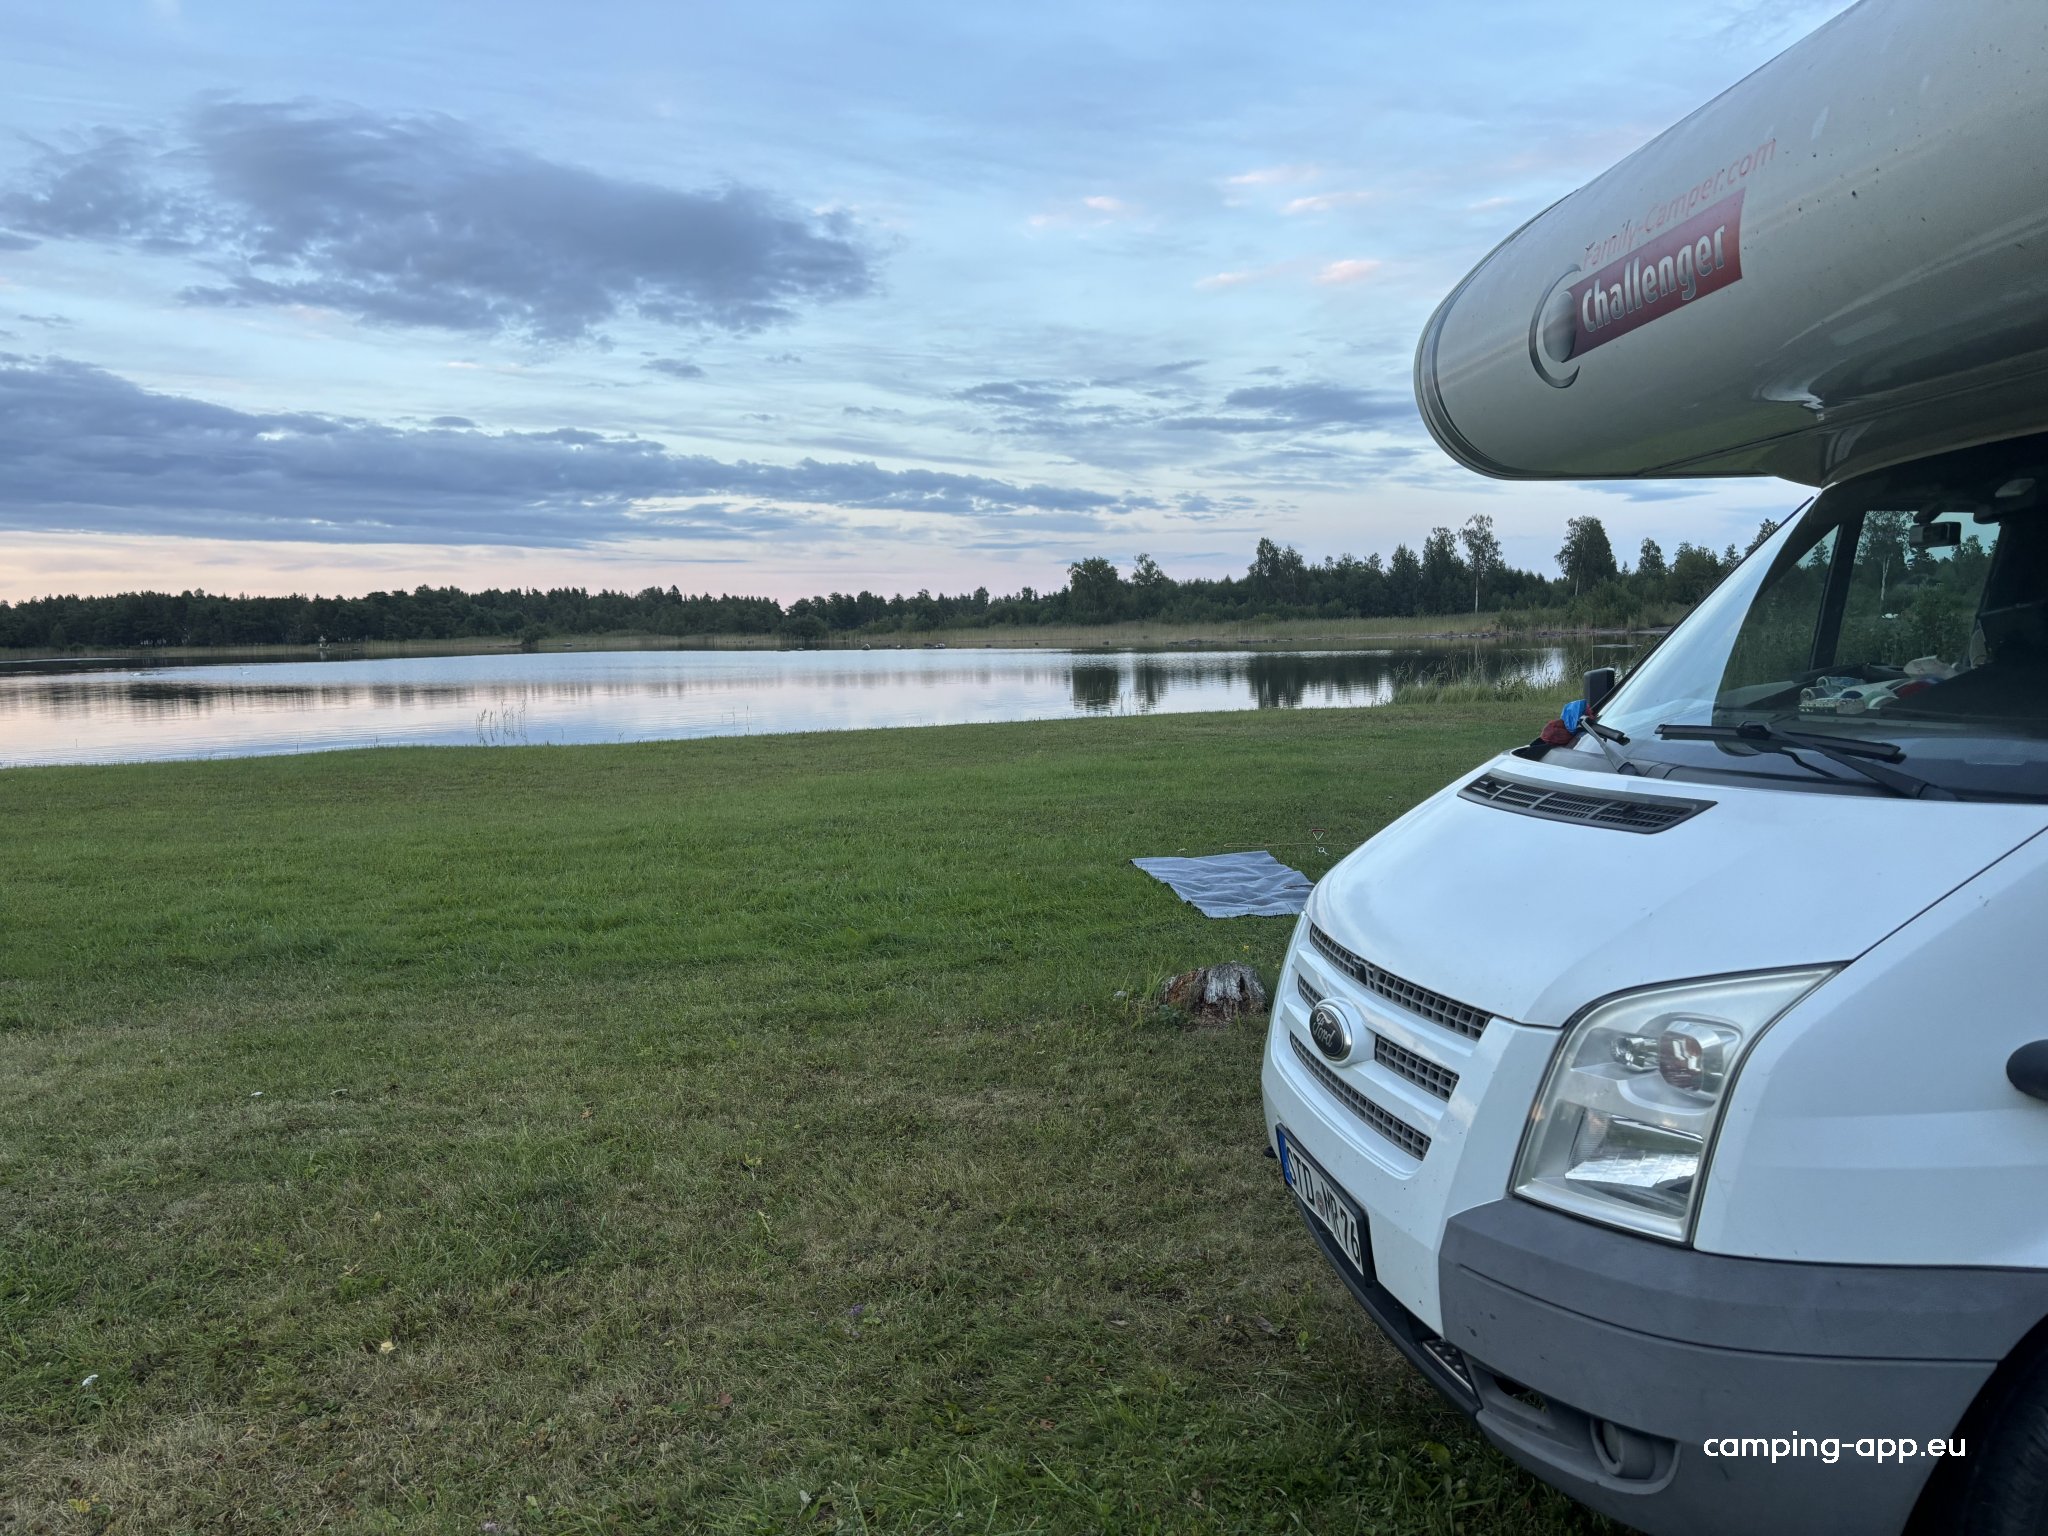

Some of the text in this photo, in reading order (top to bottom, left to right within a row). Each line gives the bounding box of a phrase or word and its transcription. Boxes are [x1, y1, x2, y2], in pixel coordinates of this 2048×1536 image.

[1582, 225, 1725, 333] Challenger
[1312, 1011, 1336, 1047] Ford
[1287, 1147, 1315, 1206] STD
[1339, 1205, 1361, 1265] 76
